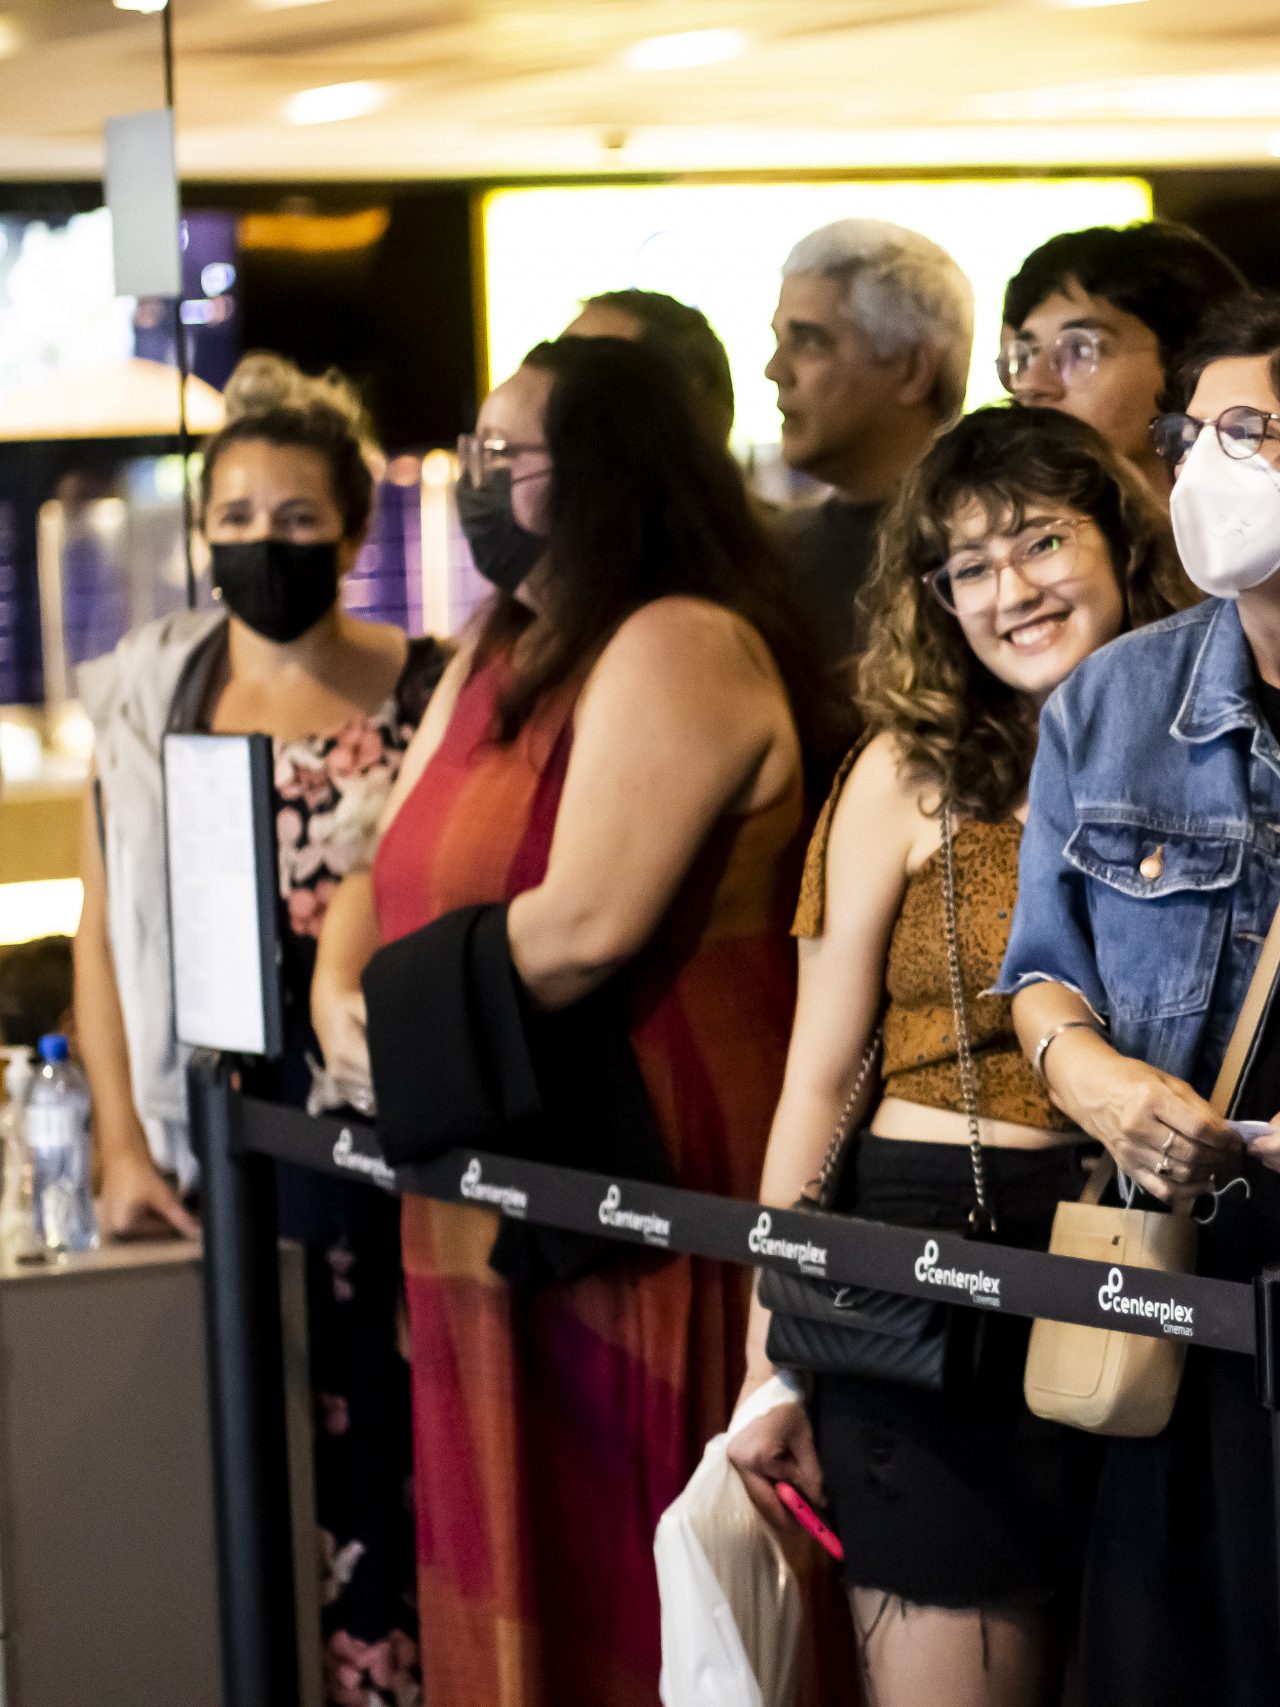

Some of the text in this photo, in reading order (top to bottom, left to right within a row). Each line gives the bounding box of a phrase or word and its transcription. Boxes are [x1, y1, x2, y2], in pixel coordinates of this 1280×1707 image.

[759, 1238, 827, 1266] centerplex
[927, 1266, 1000, 1294] centerplex
[1113, 1295, 1193, 1324] centerplex
[1163, 1323, 1193, 1336] cinemas
